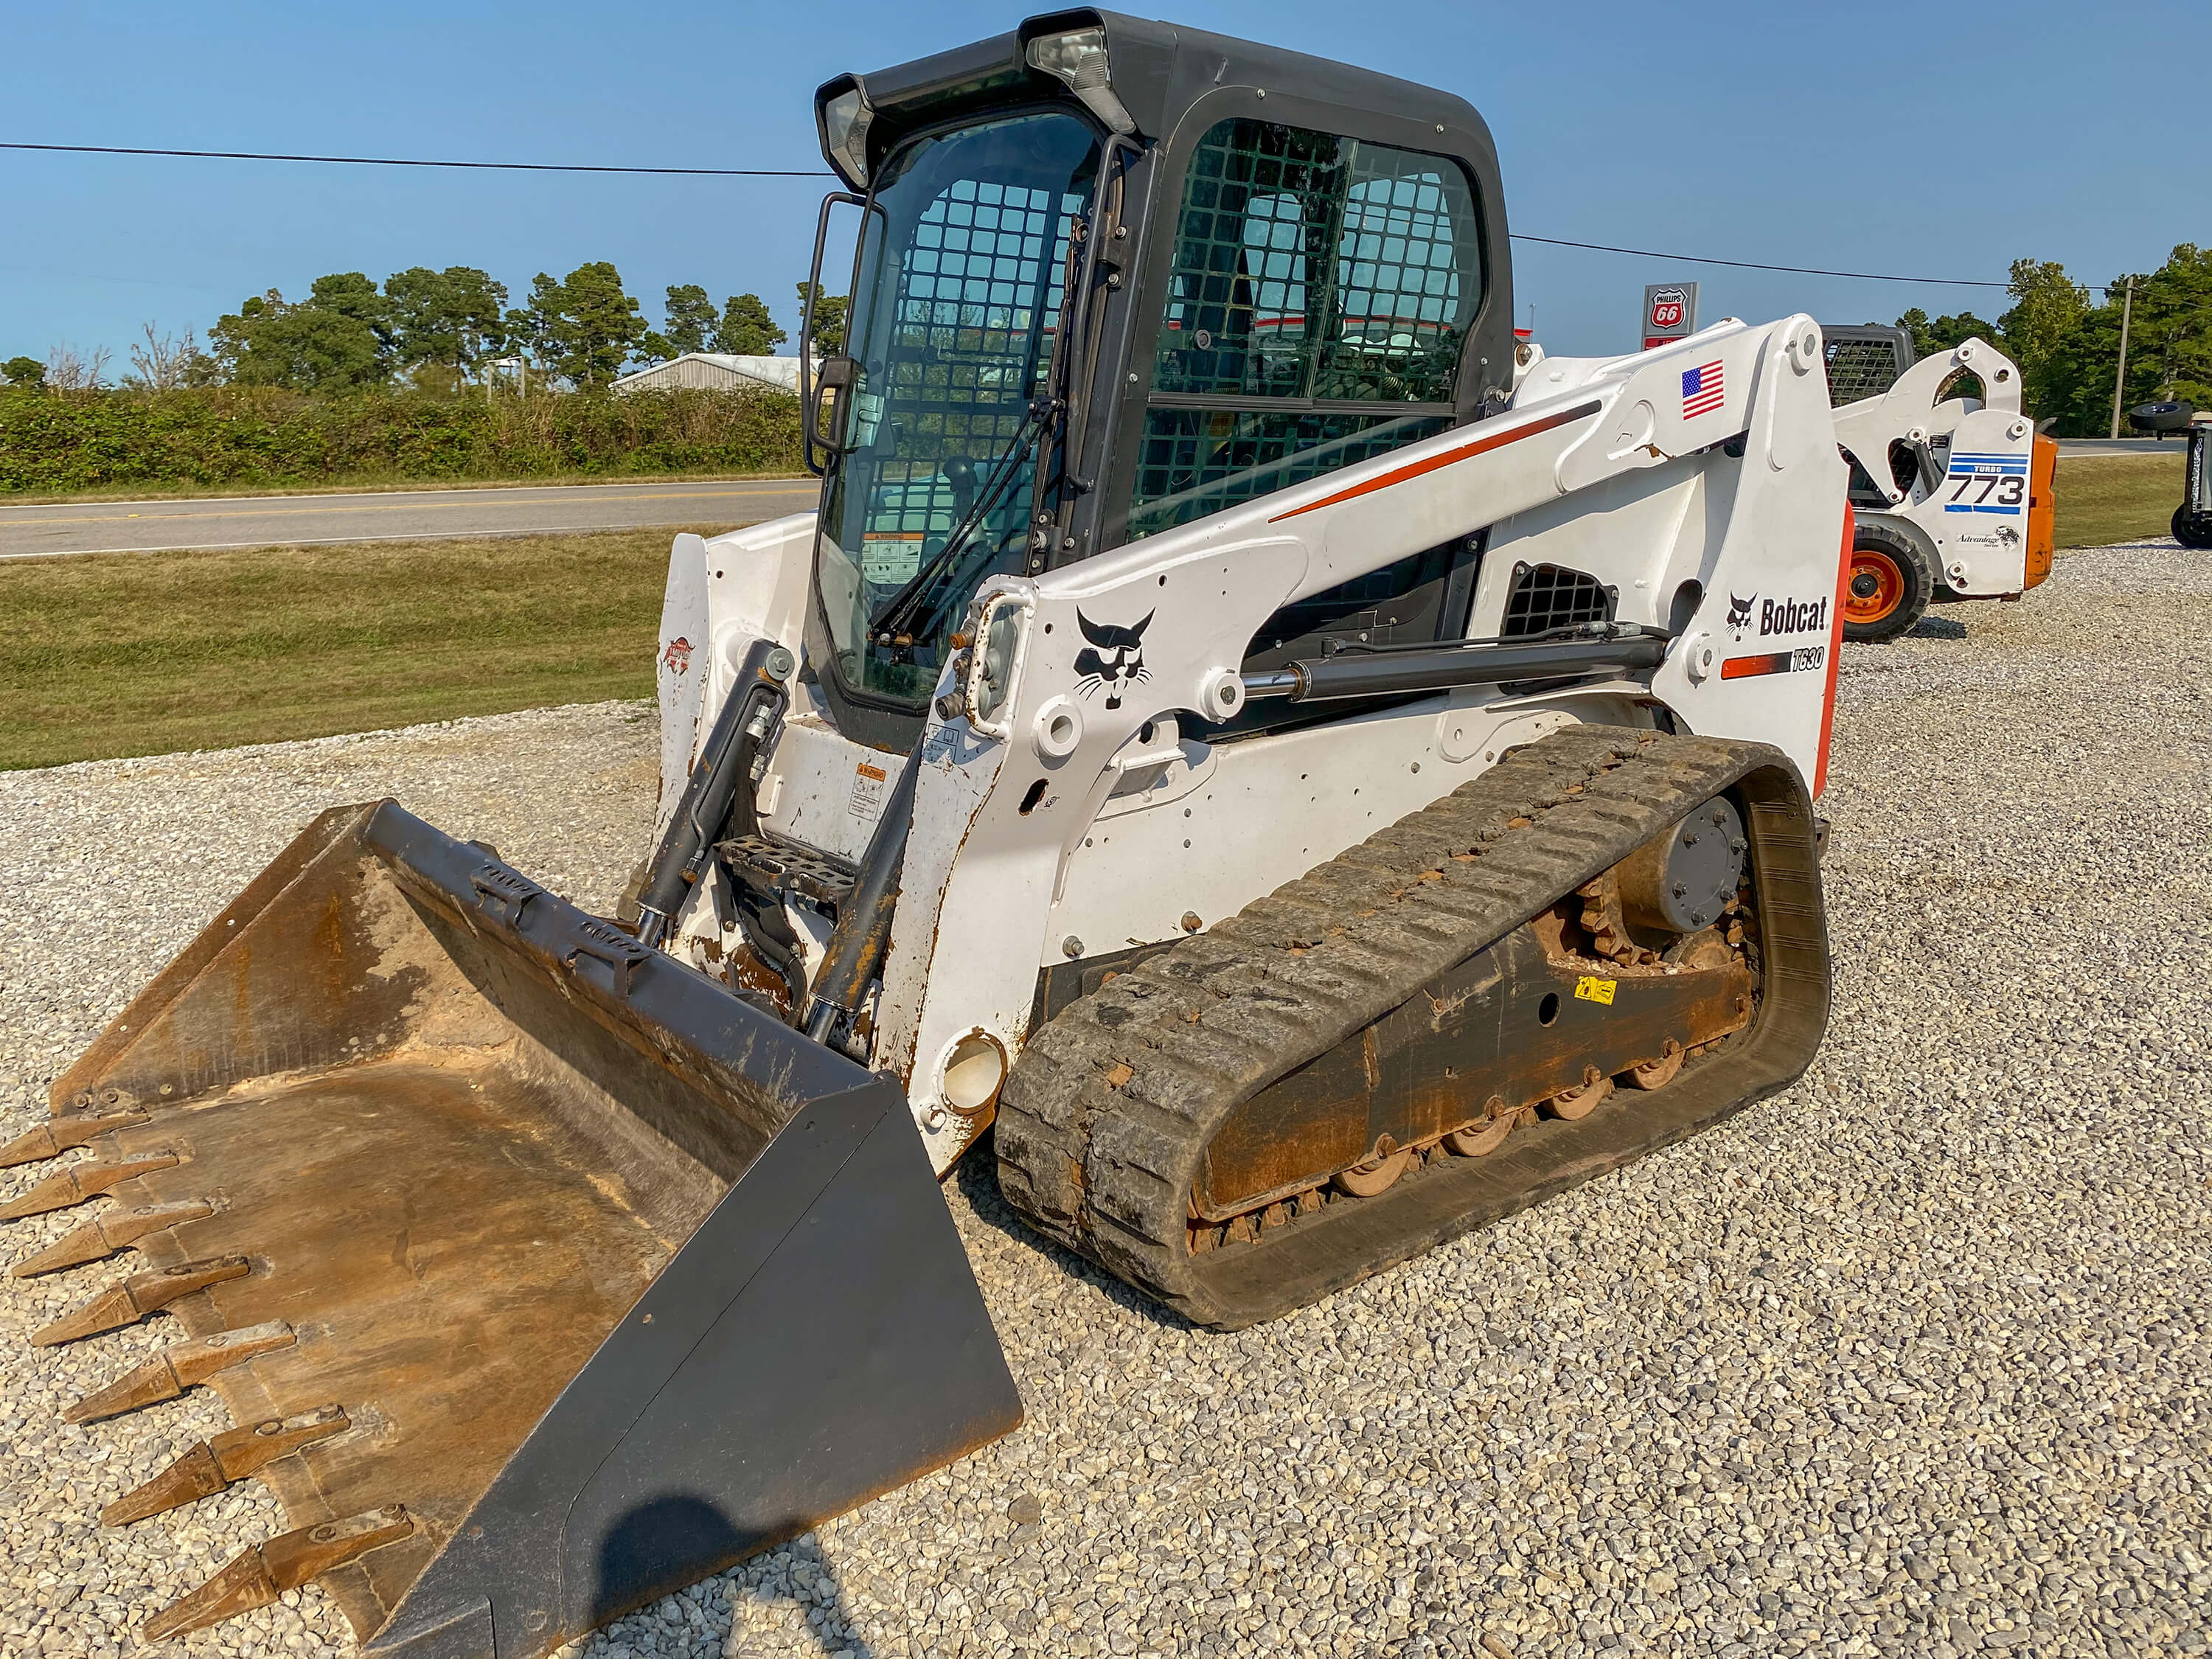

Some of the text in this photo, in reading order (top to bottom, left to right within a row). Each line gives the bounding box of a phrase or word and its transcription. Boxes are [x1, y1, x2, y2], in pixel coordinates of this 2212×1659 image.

[1657, 295, 1681, 303] PHILLIPS
[1657, 306, 1679, 321] 66
[1948, 474, 2025, 504] 773
[1956, 534, 2000, 543] Advantage
[1759, 596, 1827, 636] Bobcat
[1792, 646, 1825, 672] T630
